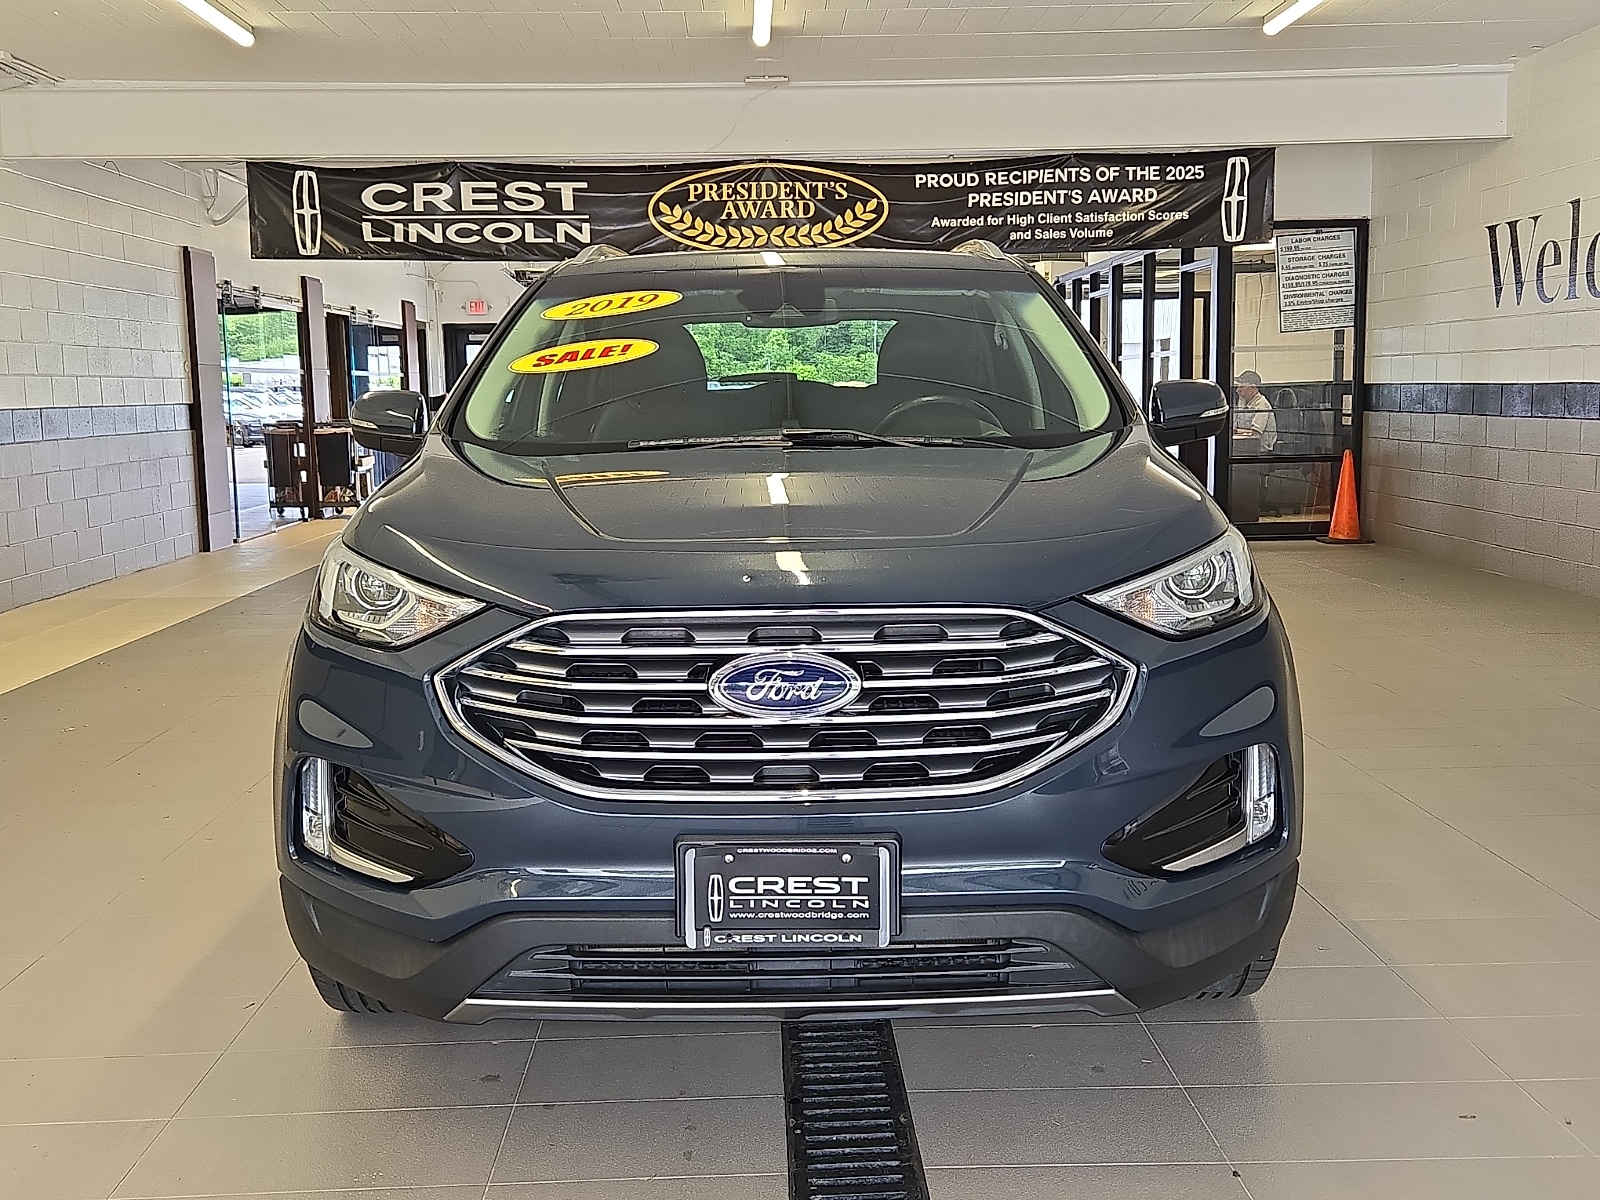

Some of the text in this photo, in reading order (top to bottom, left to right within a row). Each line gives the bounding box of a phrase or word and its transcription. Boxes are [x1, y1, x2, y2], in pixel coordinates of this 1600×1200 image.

[915, 165, 1205, 188] PROUD RECIPIENTS OF THE 2025
[361, 181, 588, 213] CREST
[687, 181, 848, 202] PRESIDENT'S
[967, 187, 1158, 208] PRESIDENT'S AWARD
[720, 199, 816, 220] AWARD
[931, 208, 1190, 228] Awarded for High Client Satisfaction Scores
[361, 221, 591, 244] LINCOLN
[1009, 227, 1114, 241] and Sales Volume
[1312, 234, 1341, 242] CHARGES
[1287, 253, 1346, 263] STORAGE CHARGES
[1285, 271, 1350, 281] DIAGNOSTIC CHARGES
[1283, 288, 1353, 300] ENVIRONMENTAL CHARGES
[470, 301, 484, 313] EXIT
[564, 293, 660, 317] 2019
[532, 343, 635, 368] SALE!
[746, 669, 825, 701] Ford
[728, 876, 869, 894] CREST
[729, 899, 870, 909] LINCOLN
[728, 910, 870, 920] www.crestwoodbridge.com
[714, 933, 862, 943] CREST LINCOLN
